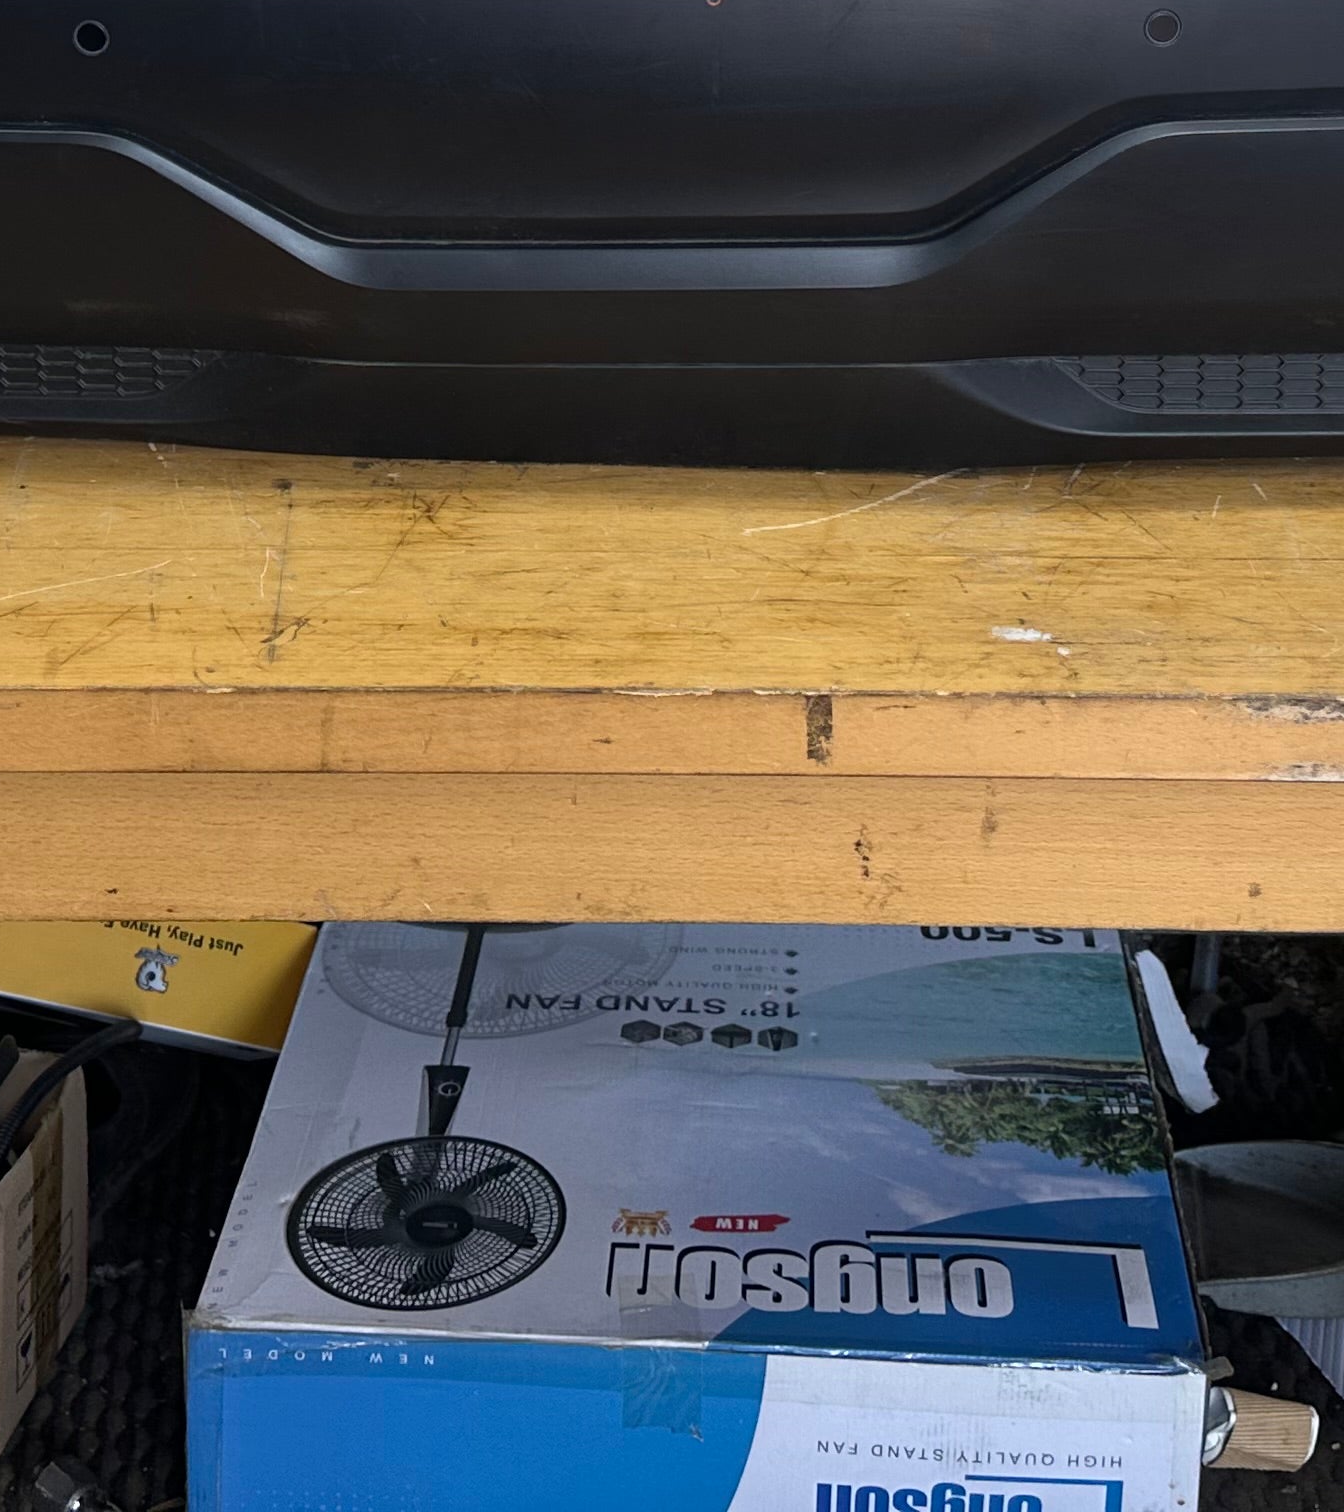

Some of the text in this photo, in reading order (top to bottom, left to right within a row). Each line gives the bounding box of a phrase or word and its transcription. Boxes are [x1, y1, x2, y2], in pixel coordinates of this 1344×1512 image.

[167, 926, 204, 948] Play,
[208, 938, 244, 956] Just
[666, 980, 737, 991] QUALITY
[506, 993, 582, 1010] FAN
[596, 994, 726, 1015] STAND
[715, 1217, 758, 1231] NEW
[219, 1348, 434, 1365] NEW MODEL
[817, 1440, 1122, 1468] HIGH QUALITY STAND FAN
